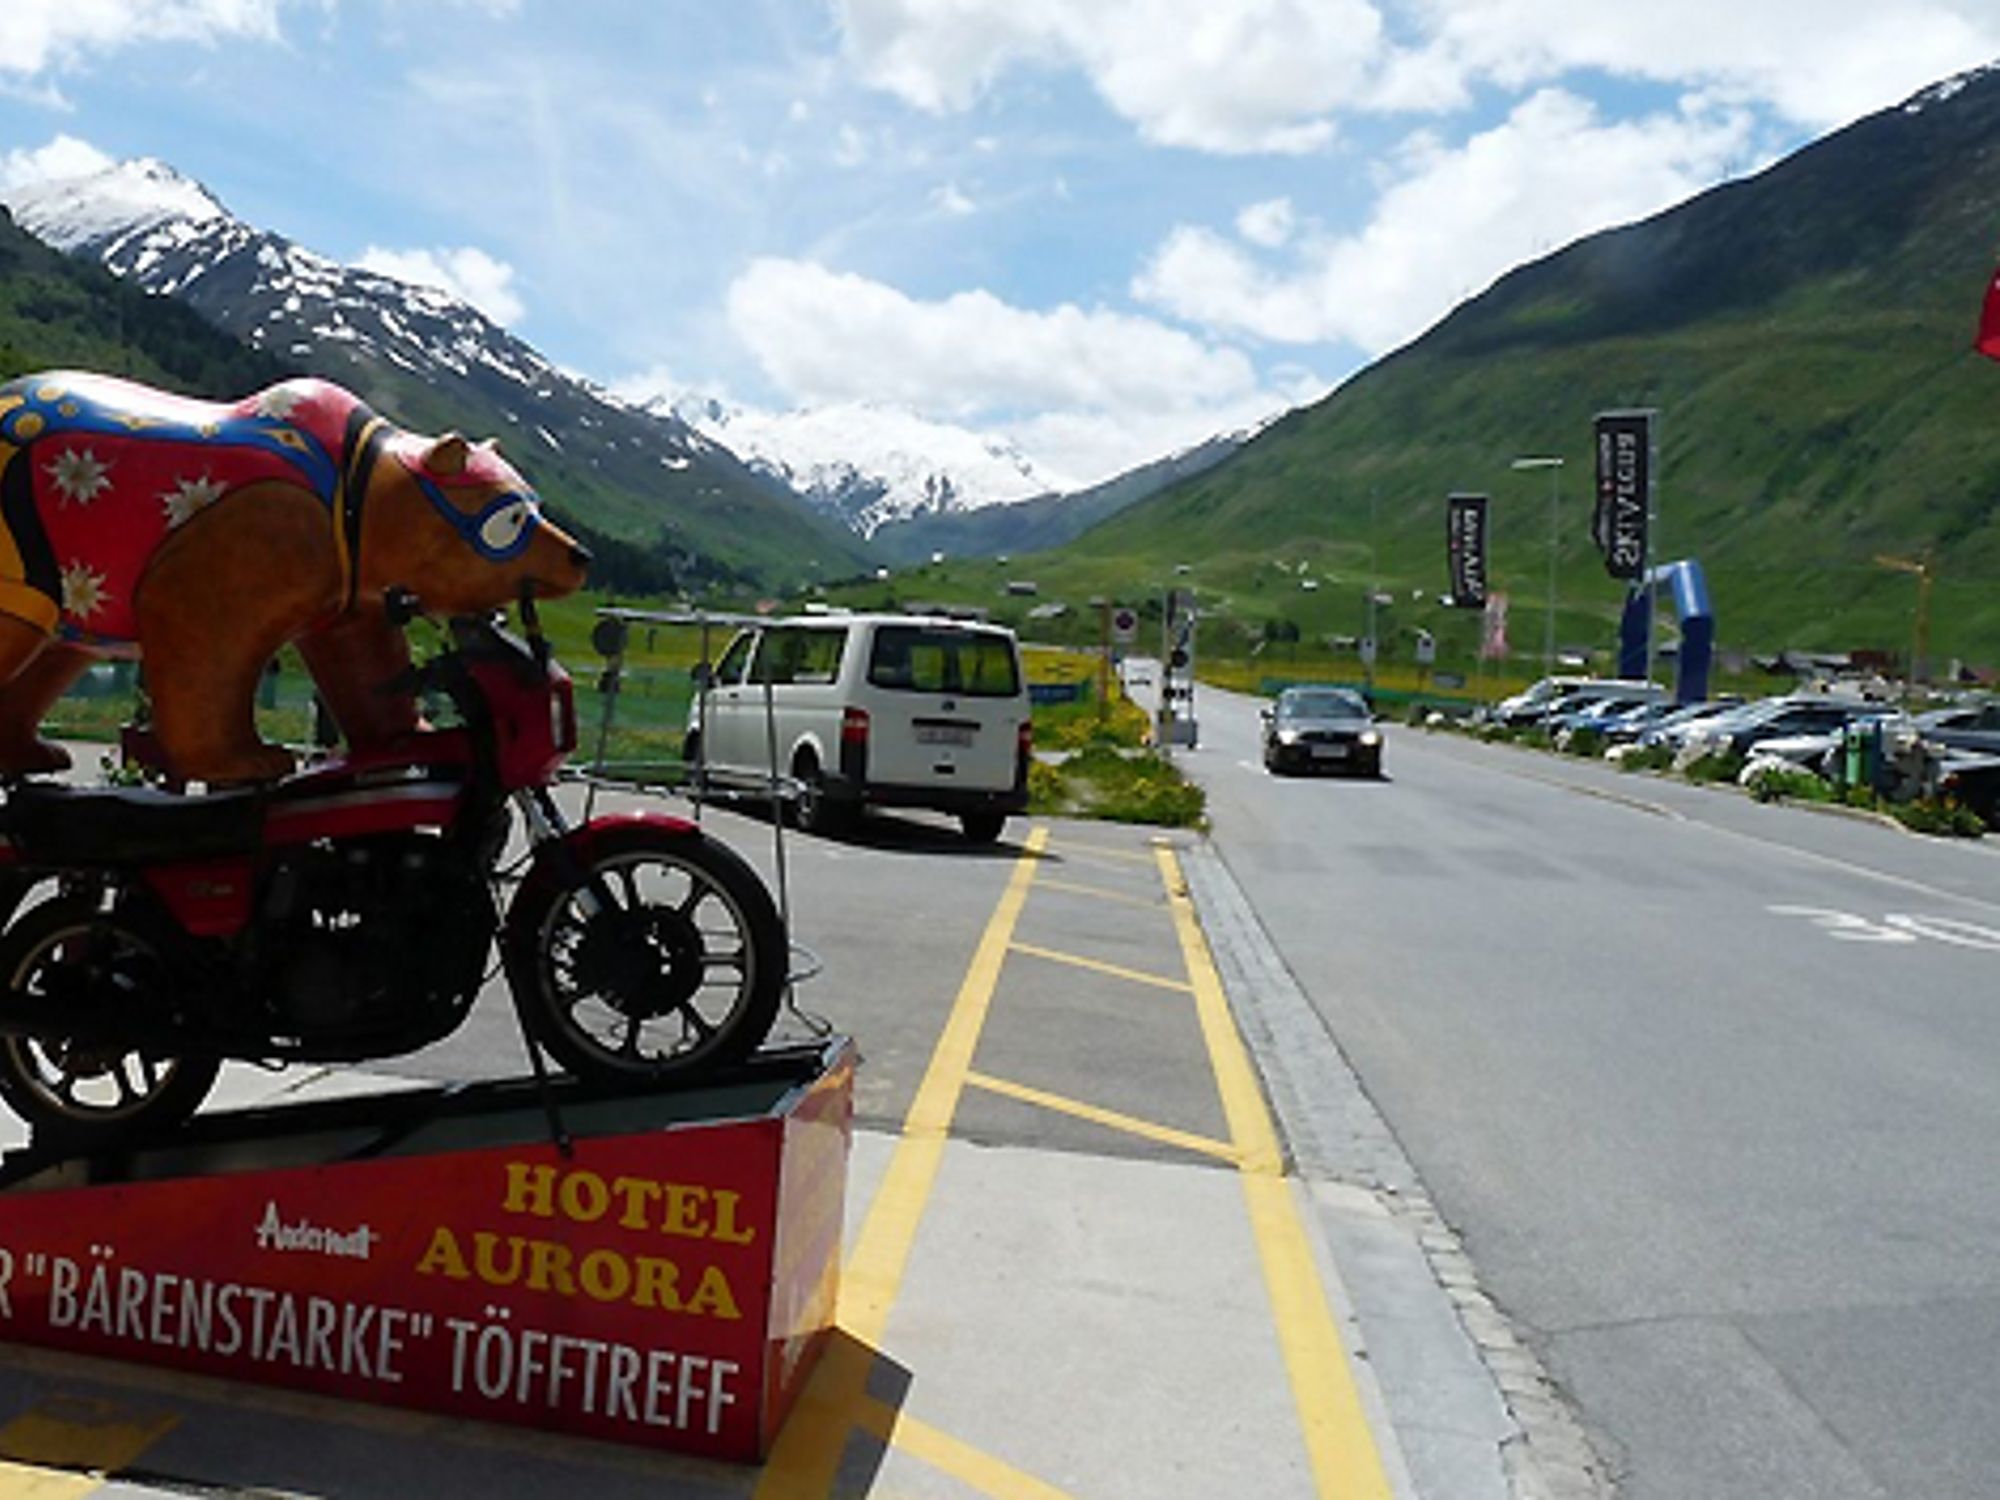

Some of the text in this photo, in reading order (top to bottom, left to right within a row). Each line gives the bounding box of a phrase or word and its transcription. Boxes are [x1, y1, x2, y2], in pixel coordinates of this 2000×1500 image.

[503, 1163, 755, 1243] HOTEL
[416, 1227, 742, 1319] AURORA
[26, 1244, 433, 1382] "BÄRENSTARKE"
[445, 1304, 740, 1434] TÖFFTREFF
